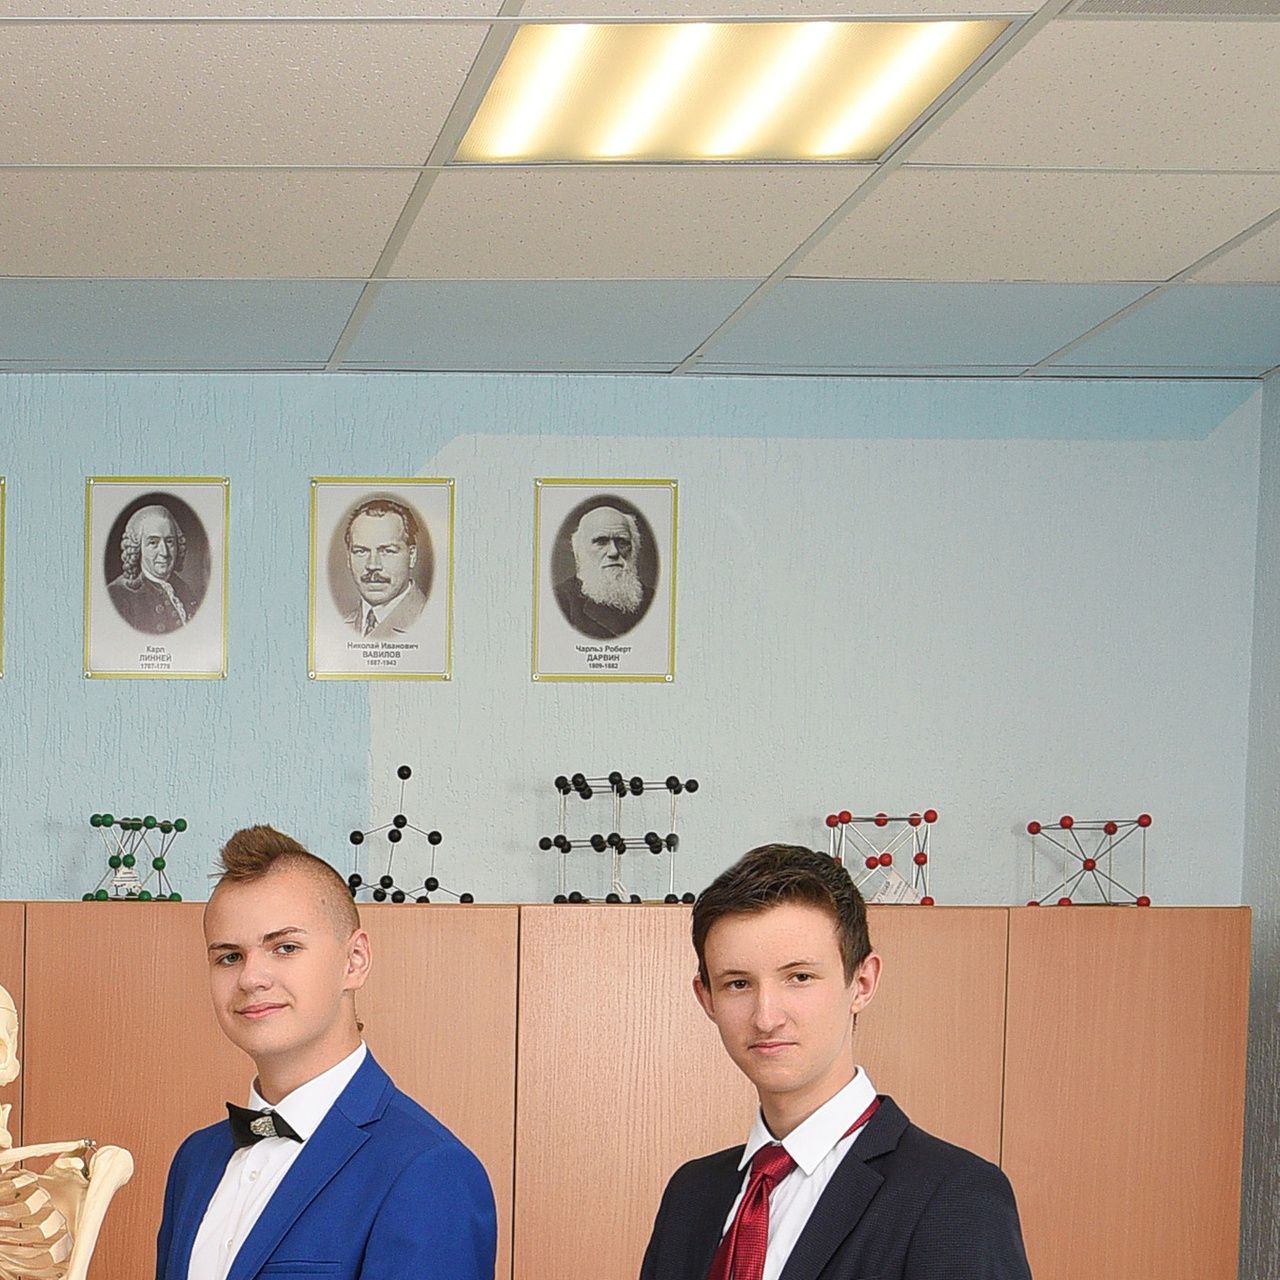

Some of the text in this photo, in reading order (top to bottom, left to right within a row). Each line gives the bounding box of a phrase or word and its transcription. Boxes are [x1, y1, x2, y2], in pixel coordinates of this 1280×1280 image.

[381, 642, 419, 650] Иванович
[575, 645, 632, 653] Чарльз Роберт
[139, 653, 172, 662] ЛИННЕЙ
[587, 654, 620, 662] ДАРВИН
